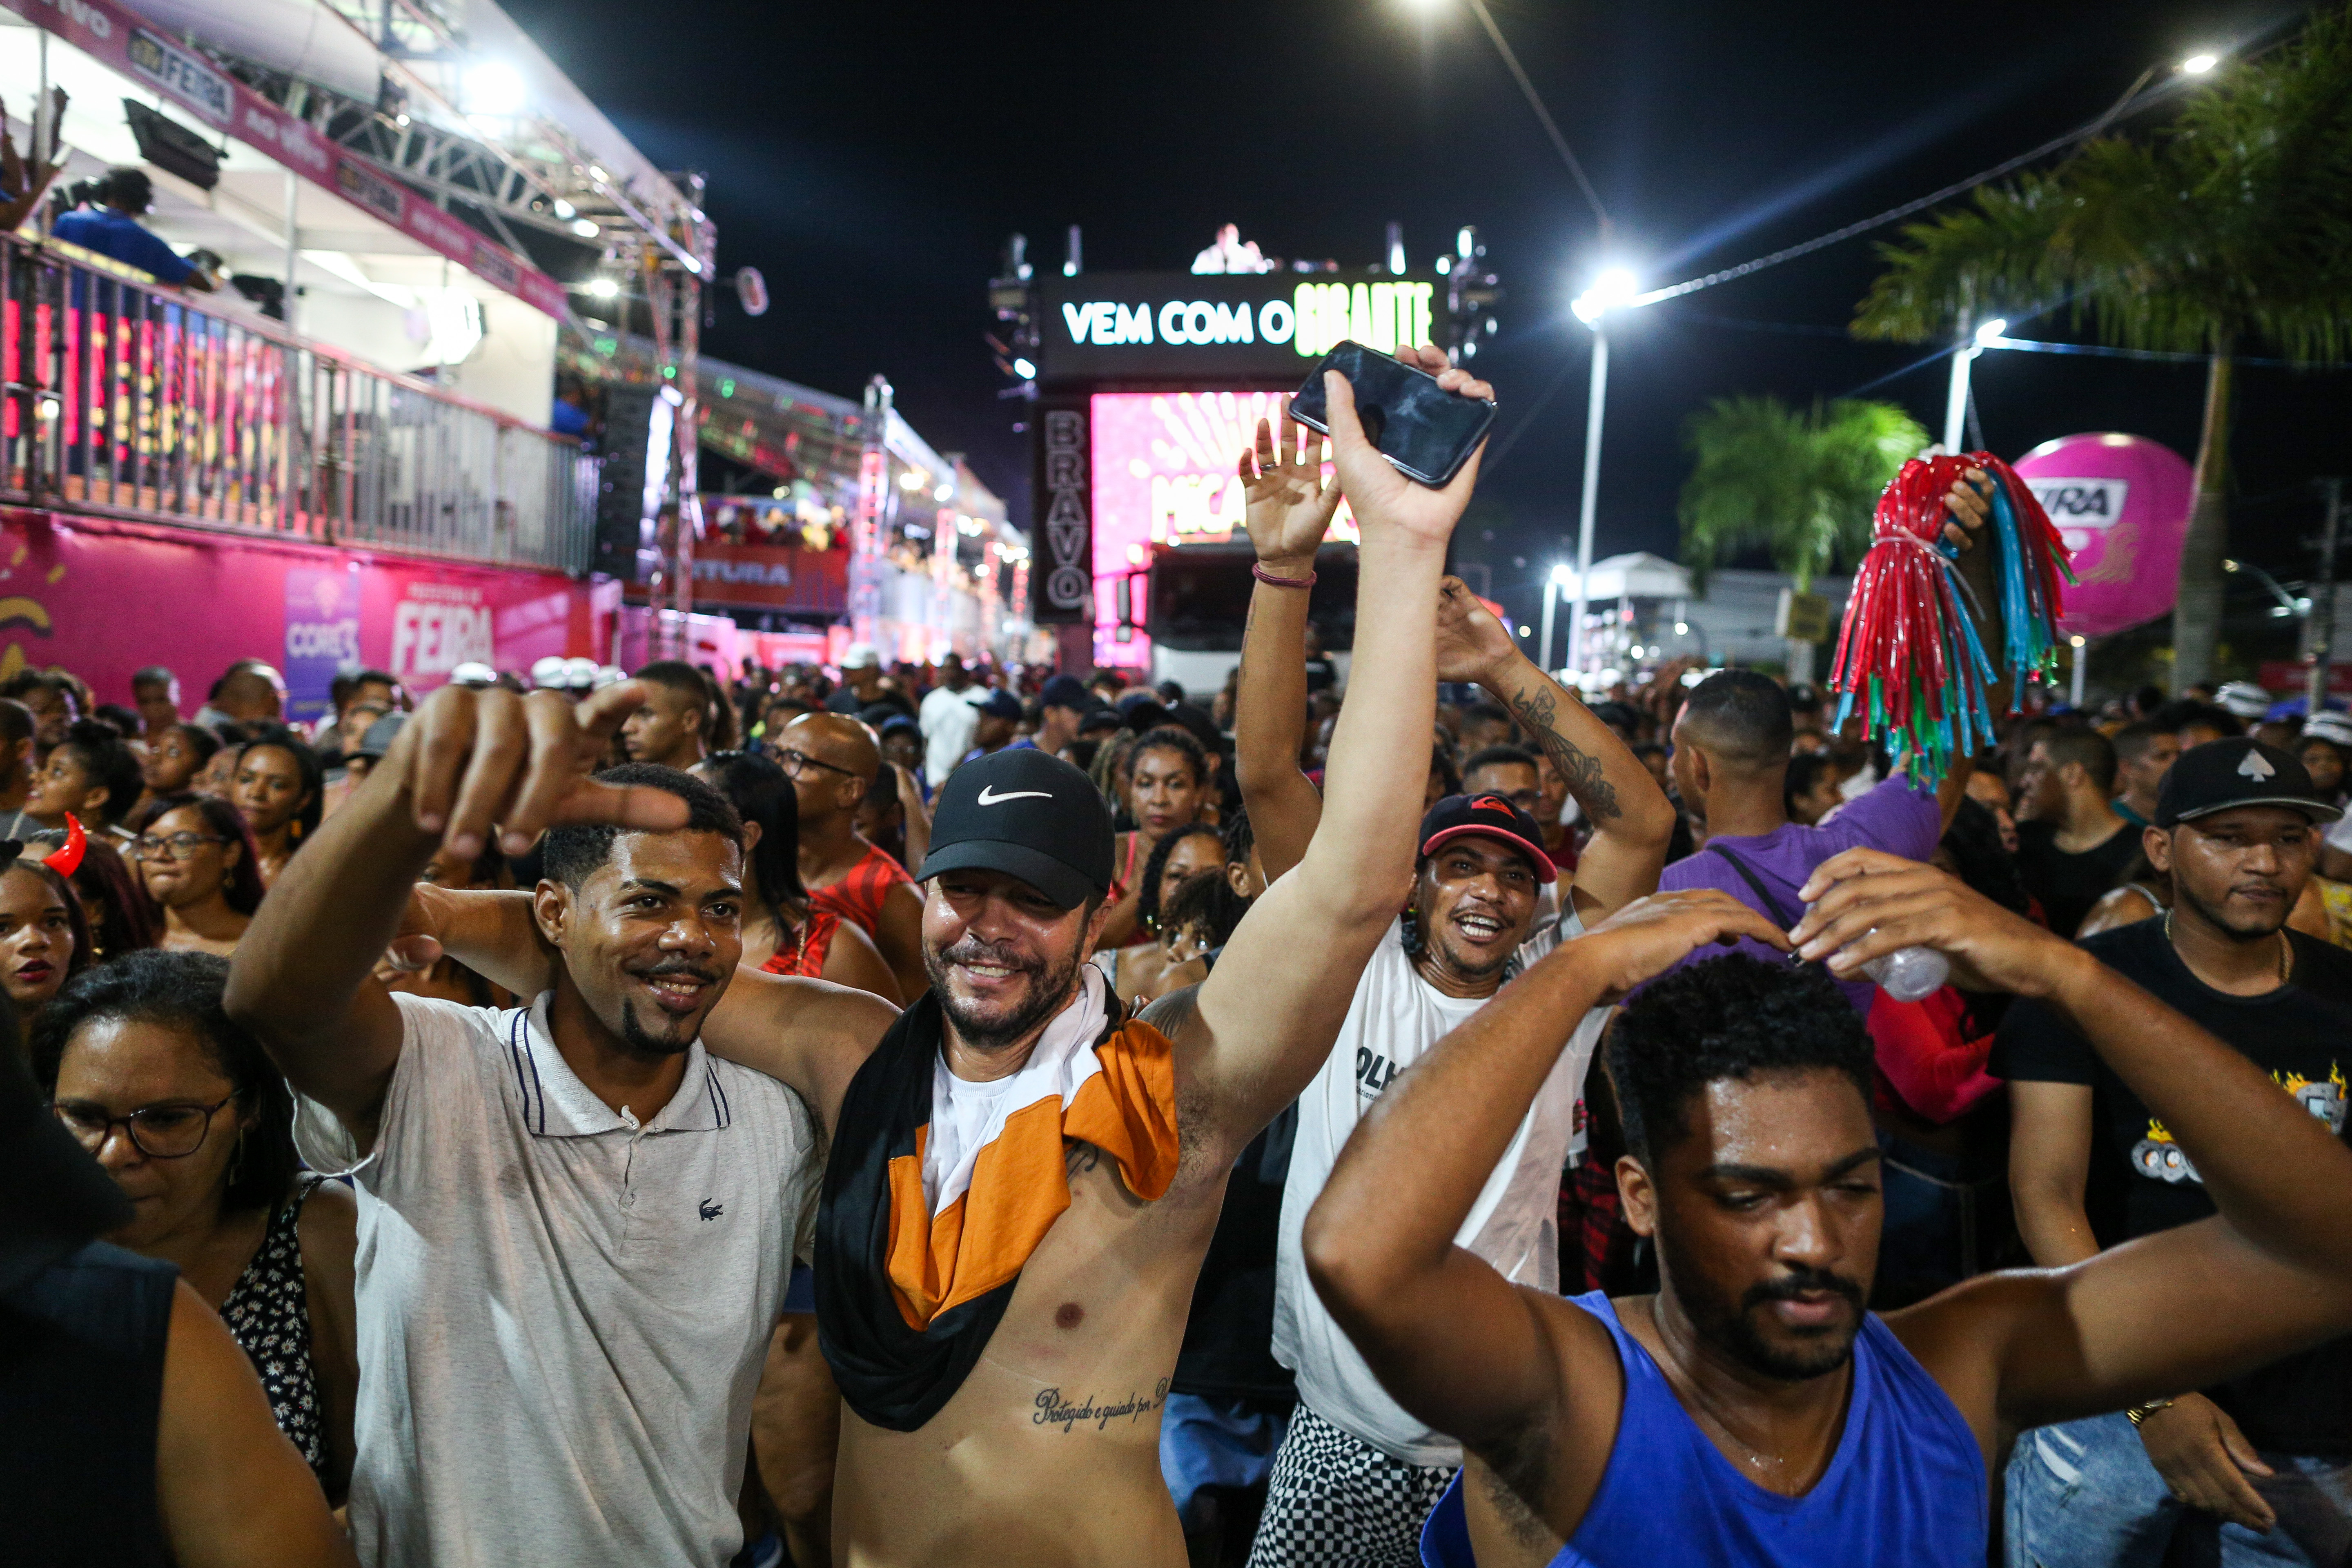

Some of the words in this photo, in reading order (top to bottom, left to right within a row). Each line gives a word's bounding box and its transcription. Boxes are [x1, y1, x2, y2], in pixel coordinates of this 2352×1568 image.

[1062, 301, 1154, 345] VEM
[1158, 300, 1254, 345] COM
[1258, 299, 1295, 344] O
[1045, 410, 1089, 609] BRAVO
[1033, 1388, 1094, 1432] Protegido
[1095, 1407, 1101, 1418] e
[1099, 1391, 1136, 1430] guiado
[1133, 1396, 1150, 1423] por
